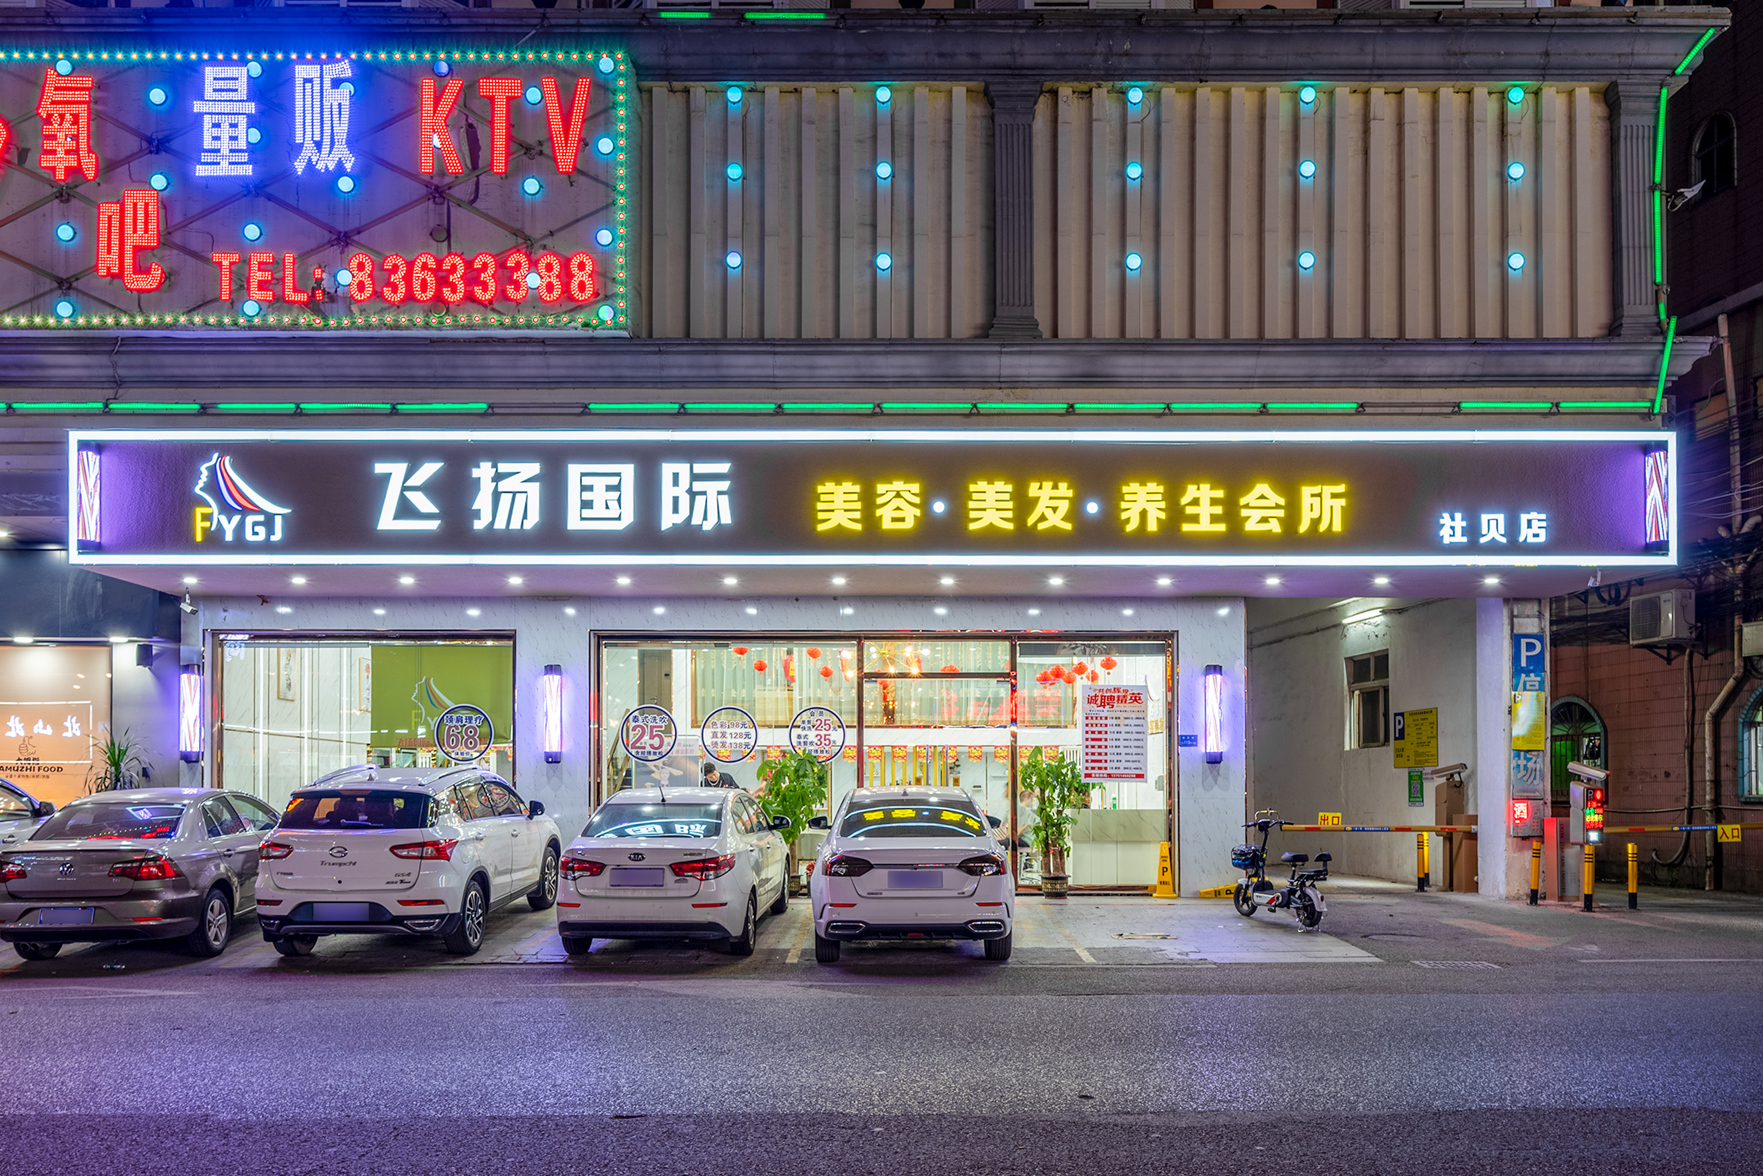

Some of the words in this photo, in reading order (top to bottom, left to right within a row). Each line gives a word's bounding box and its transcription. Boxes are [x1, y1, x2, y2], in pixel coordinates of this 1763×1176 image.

[194, 58, 355, 176] 量贩
[420, 77, 591, 175] KTV
[97, 189, 164, 293] 吧
[211, 252, 325, 302] TEL:
[348, 252, 594, 302] 83633388
[374, 461, 733, 532] 飞扬国际
[195, 506, 284, 542] FYGJ
[1439, 511, 1549, 545] 社贝店
[1521, 638, 1542, 667] P
[1086, 692, 1144, 709] 诚聘精英
[632, 715, 668, 724] 泰式洗吹
[711, 721, 727, 729] 色彩
[815, 718, 832, 731] 25
[1395, 715, 1404, 738] P
[445, 724, 480, 750] 68
[630, 724, 665, 750] 25
[711, 731, 727, 739] 直发
[729, 731, 752, 740] 128元
[815, 733, 832, 747] 35
[1319, 813, 1340, 826] 出口
[1719, 827, 1740, 840] 入口
[320, 860, 358, 868] Trumpchi
[1162, 866, 1168, 876] P
